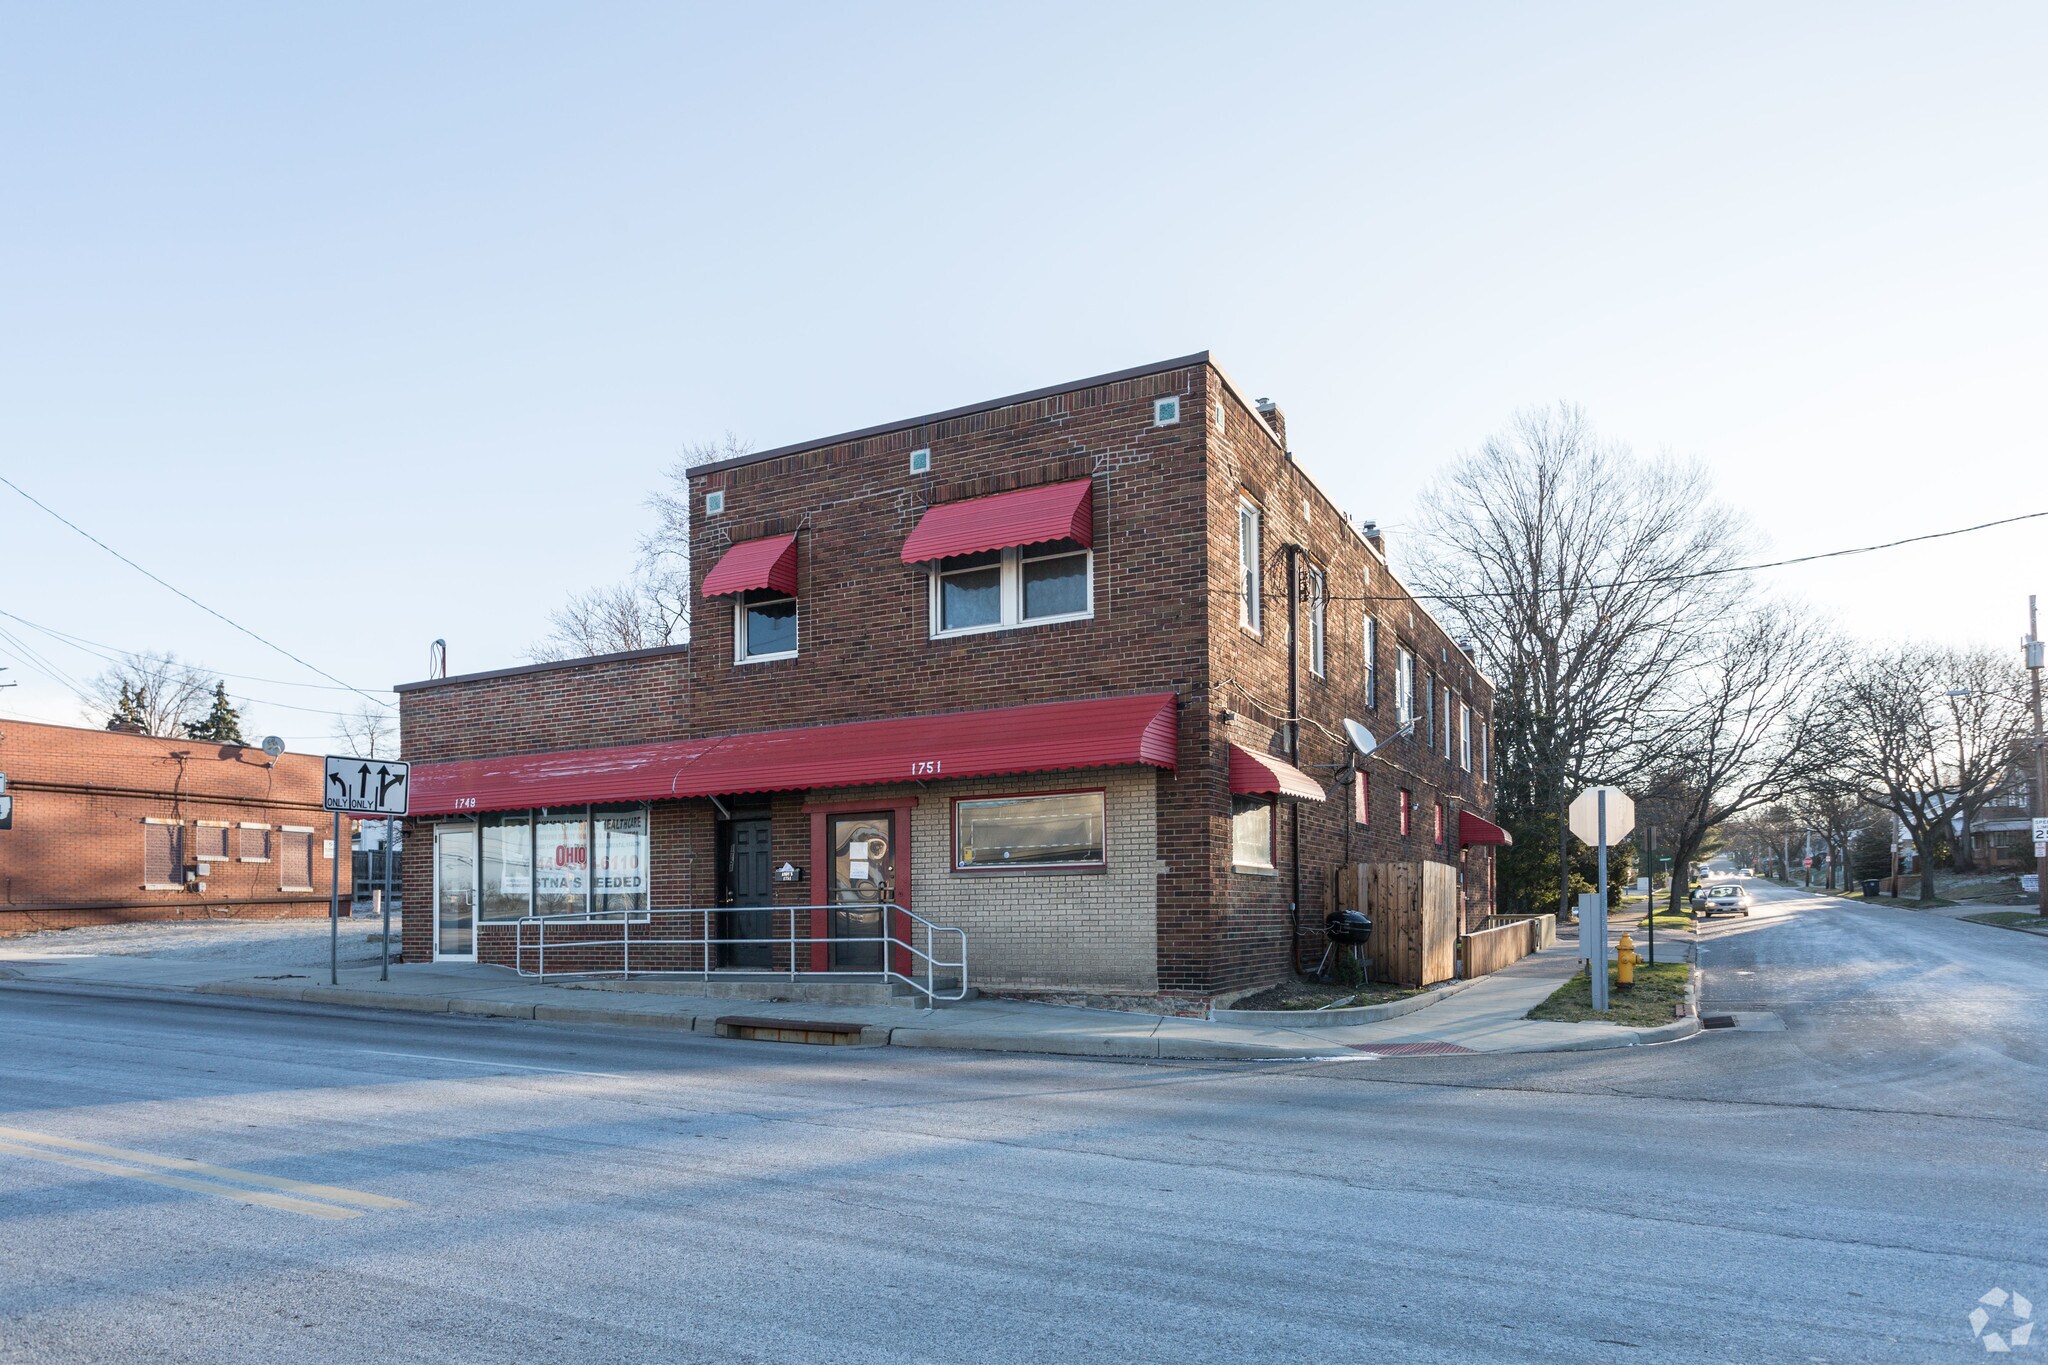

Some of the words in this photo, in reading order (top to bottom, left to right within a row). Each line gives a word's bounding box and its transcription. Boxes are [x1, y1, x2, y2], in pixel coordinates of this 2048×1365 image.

[912, 761, 941, 775] 1751
[327, 797, 348, 807] ONLY
[351, 799, 374, 809] ONLY
